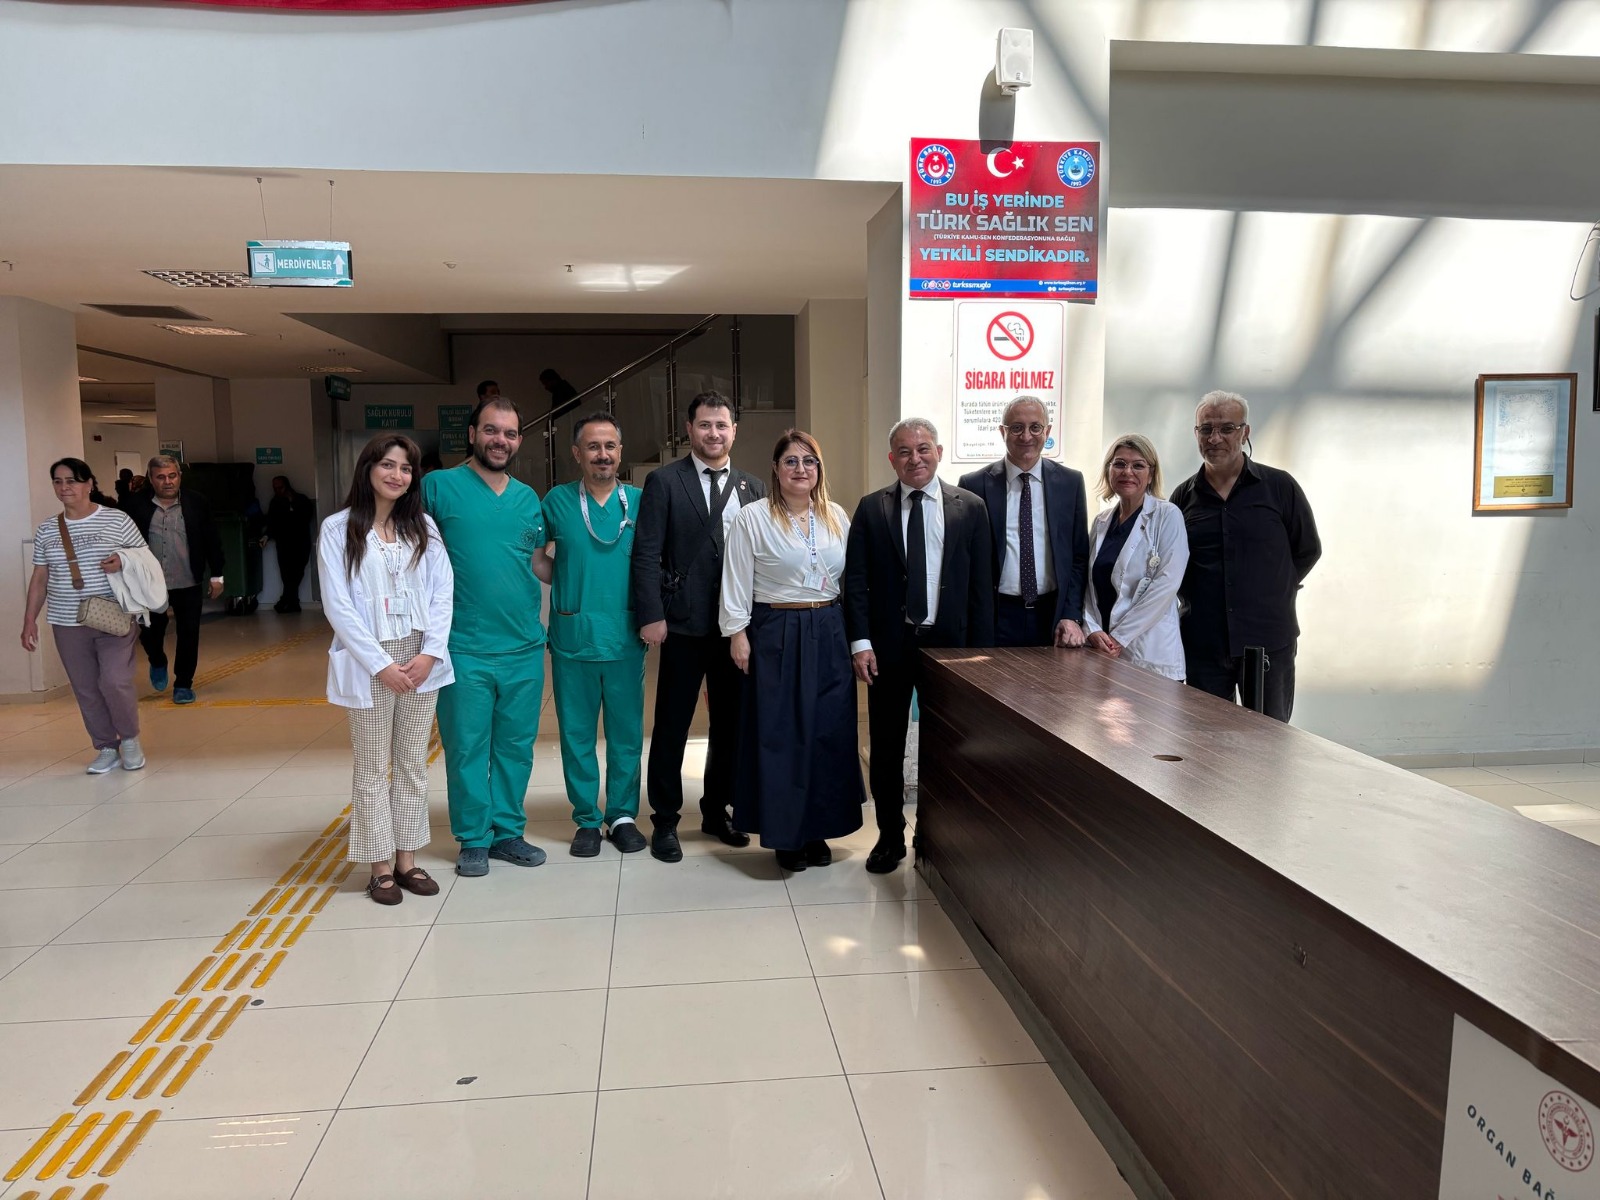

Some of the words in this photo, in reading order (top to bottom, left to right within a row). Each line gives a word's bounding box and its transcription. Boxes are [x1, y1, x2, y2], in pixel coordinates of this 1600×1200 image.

[945, 193, 968, 206] BU
[973, 190, 988, 210] İŞ
[993, 191, 1064, 208] YERİNDE
[917, 209, 971, 231] TÜRK
[976, 211, 1048, 232] SAĞLIK
[1054, 216, 1093, 232] SEN
[919, 244, 981, 261] YETKİLİ
[985, 246, 1090, 262] SENDİKADIR.
[277, 257, 332, 270] MERDİVENLER
[965, 368, 1006, 390] SİGARA
[1010, 368, 1054, 393] İÇİLMEZ
[367, 406, 388, 417] SAĞLIK
[388, 408, 412, 417] KURULU
[382, 418, 398, 428] KAYIT
[1467, 1104, 1516, 1168] ORGAN
